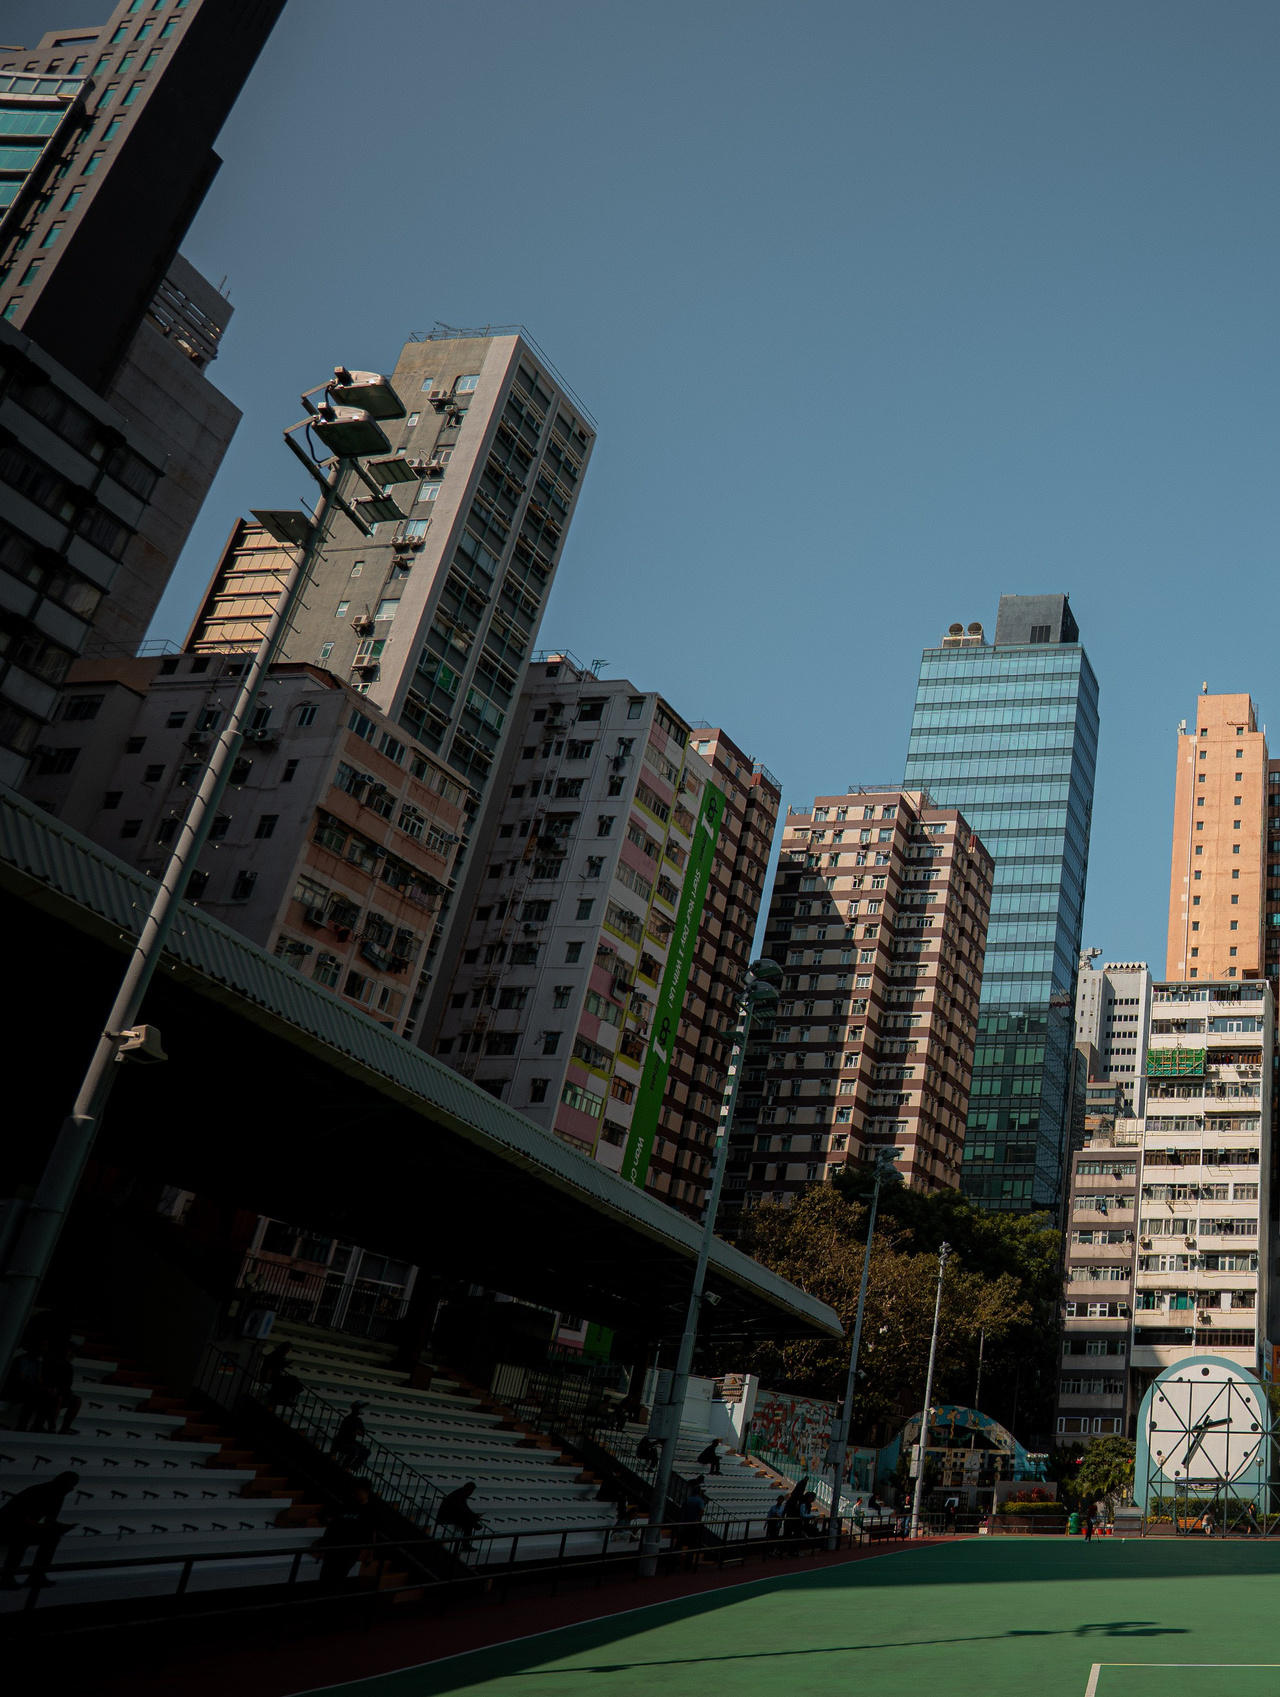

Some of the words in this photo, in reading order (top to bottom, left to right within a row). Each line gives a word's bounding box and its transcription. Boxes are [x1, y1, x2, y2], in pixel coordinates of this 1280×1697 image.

[691, 868, 701, 898] Start
[685, 898, 695, 925] Your
[680, 924, 690, 948] Day
[671, 959, 682, 986] With
[633, 1136, 645, 1166] Wan
